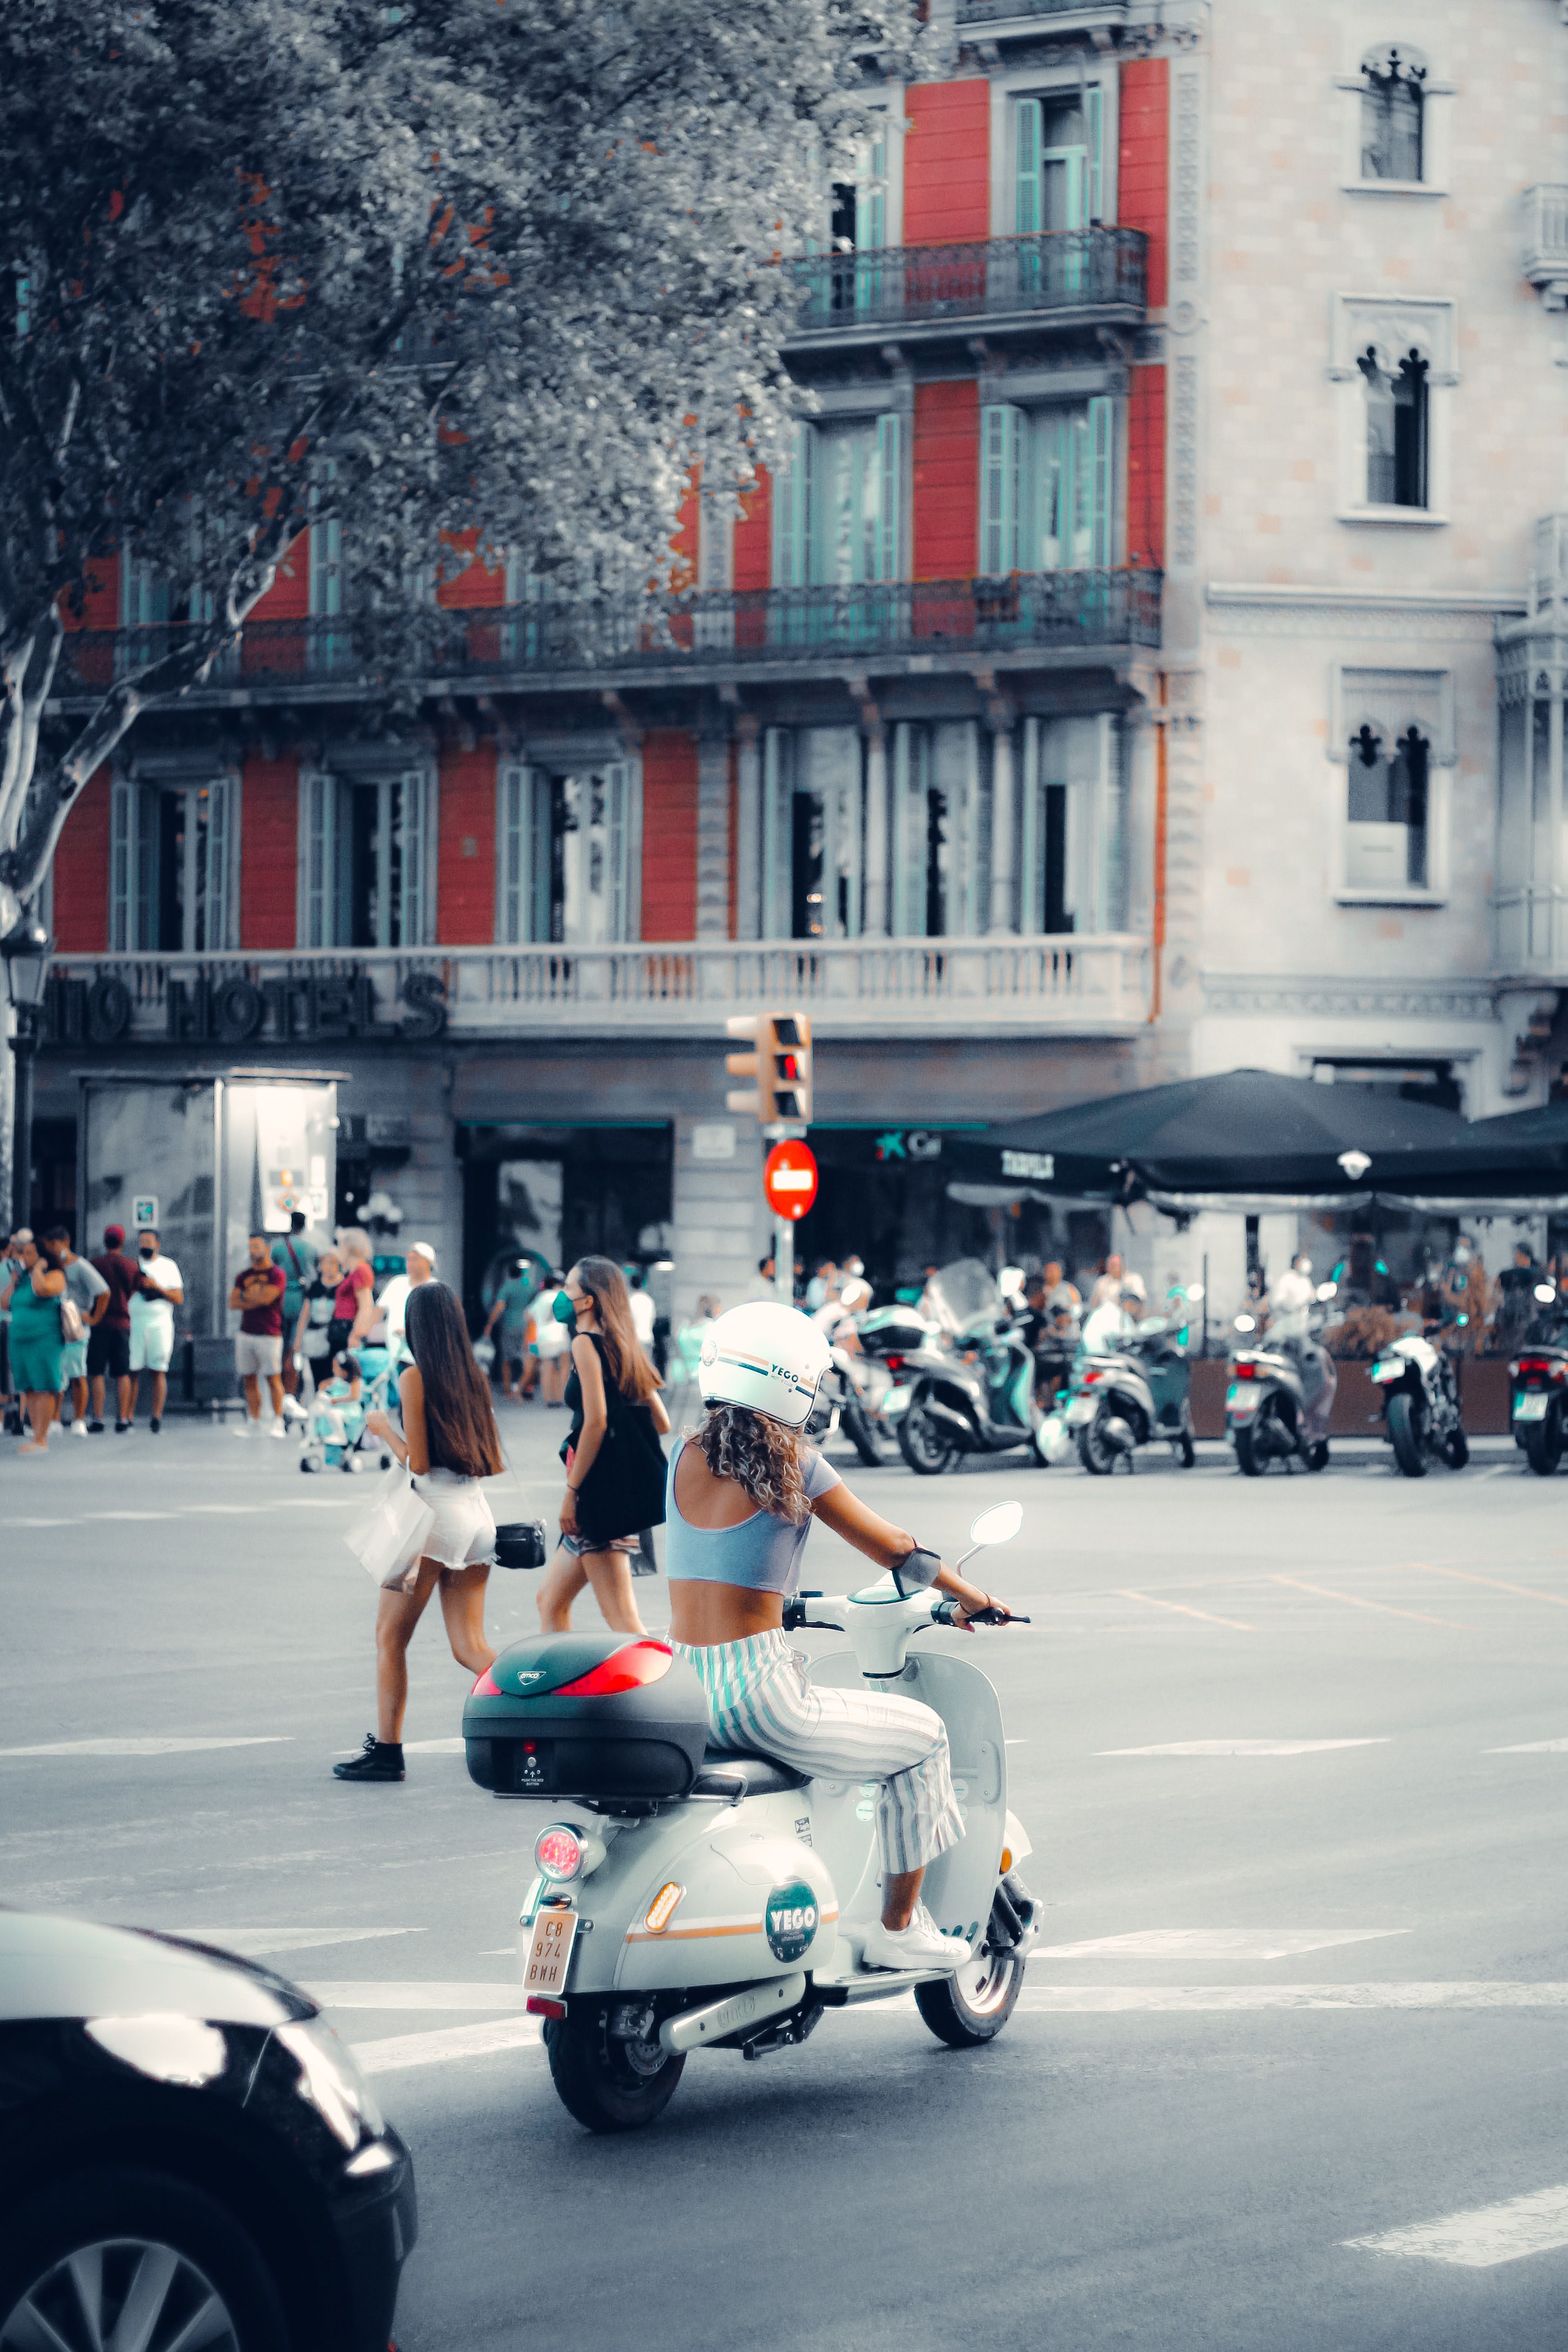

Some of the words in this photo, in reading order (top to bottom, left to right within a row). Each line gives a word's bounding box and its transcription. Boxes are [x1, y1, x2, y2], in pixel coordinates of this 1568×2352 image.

[168, 973, 447, 1042] HOTELS
[772, 1364, 798, 1382] YEGO
[770, 1907, 815, 1932] YEGO
[546, 1921, 563, 1937] C8
[535, 1942, 561, 1958] 974
[530, 1964, 557, 1981] BWH
